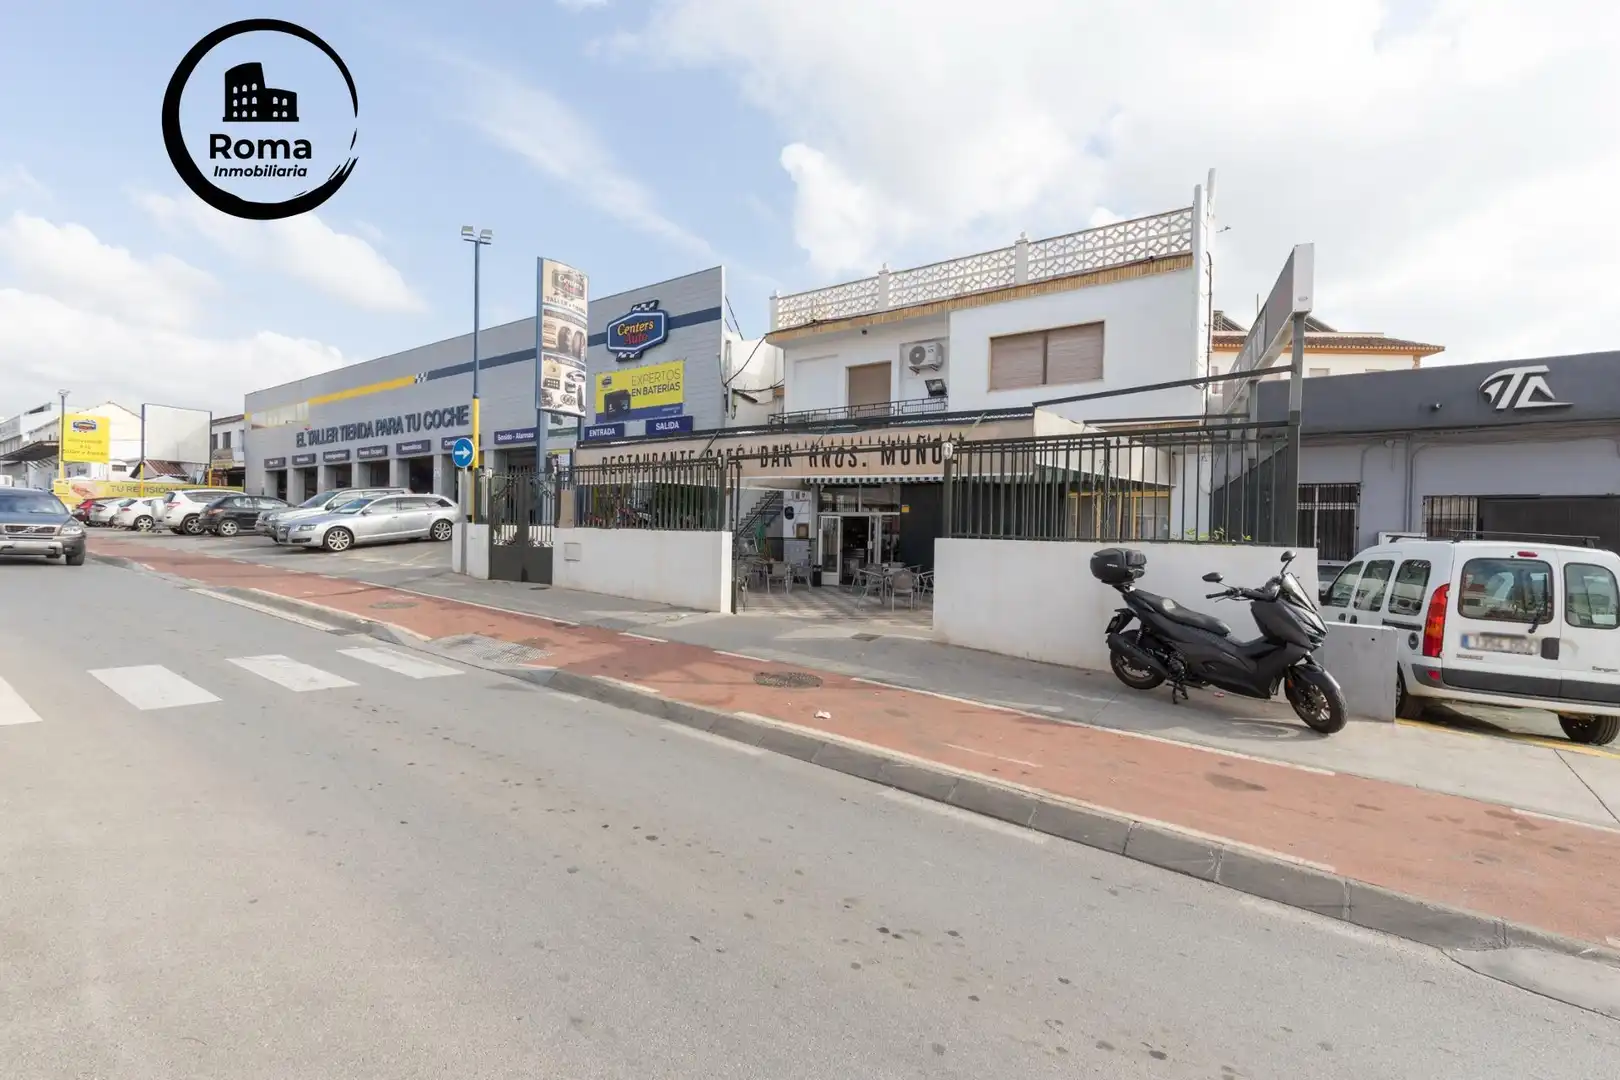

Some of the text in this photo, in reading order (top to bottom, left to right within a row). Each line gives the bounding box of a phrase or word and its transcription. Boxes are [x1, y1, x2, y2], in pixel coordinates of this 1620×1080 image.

[617, 320, 654, 336] Centers
[625, 332, 648, 345] Auto
[631, 368, 681, 386] EXPERTOS
[631, 381, 681, 397] EN BATERÍAS
[296, 405, 469, 447] EL TALLER TIENDA PARA TU COCHE
[589, 428, 616, 437] ENTRADA
[656, 421, 680, 431] SALIDA
[602, 450, 695, 475] RESTAURANTE
[760, 444, 793, 468] BAR
[111, 485, 124, 493] TU
